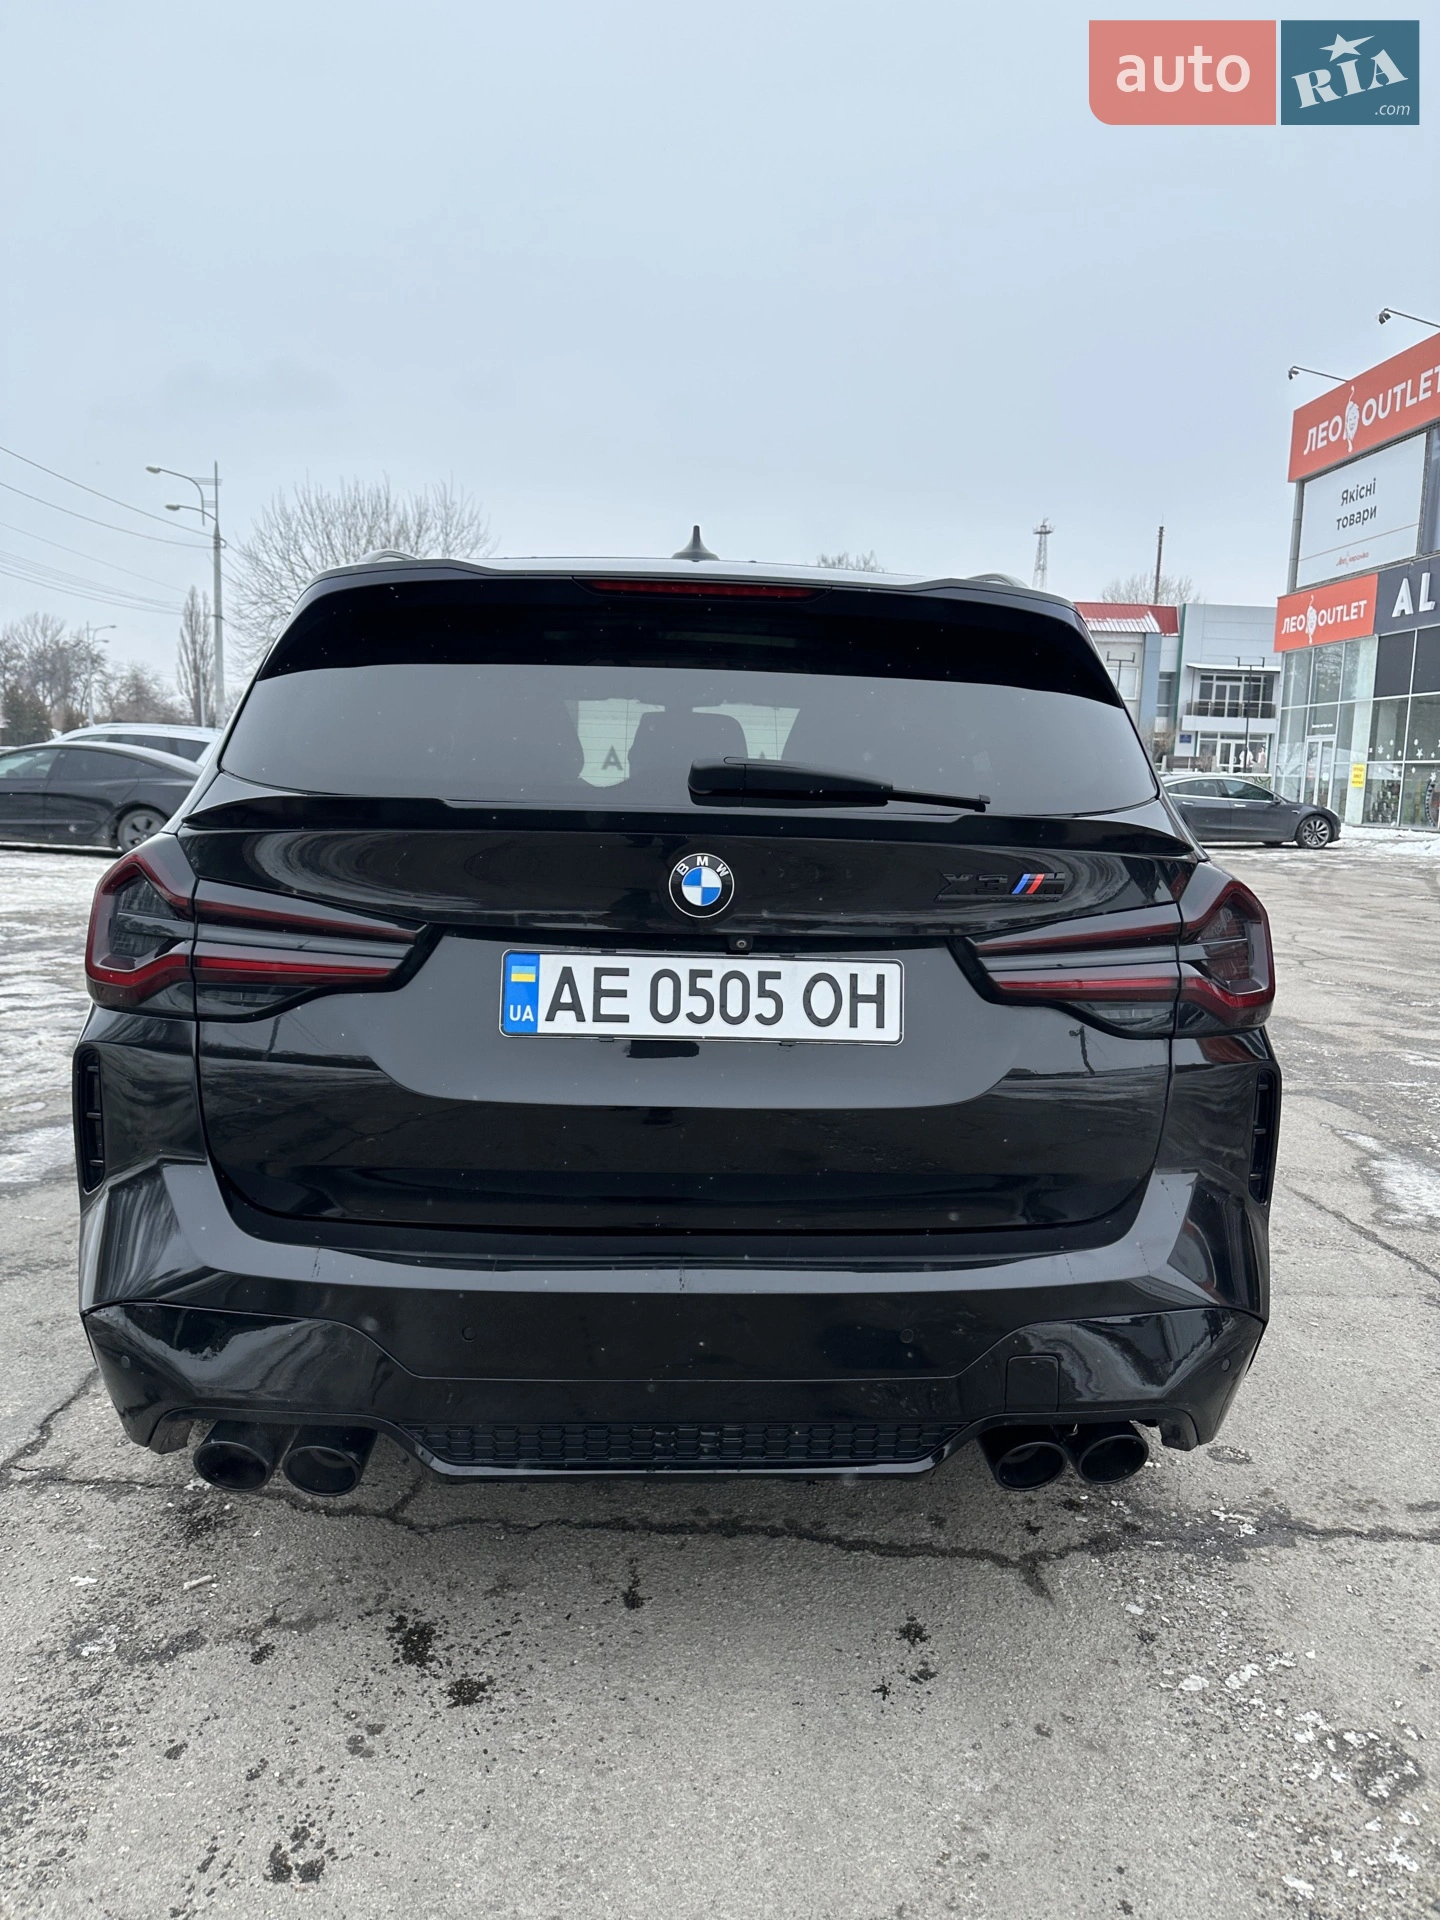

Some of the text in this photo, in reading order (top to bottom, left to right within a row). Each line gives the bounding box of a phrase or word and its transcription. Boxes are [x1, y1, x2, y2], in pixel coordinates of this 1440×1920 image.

[1303, 415, 1342, 455] ЛЕО
[1340, 477, 1377, 506] Якісні
[1336, 506, 1377, 531] товари
[1281, 600, 1367, 634] ЛЕО OUTLET
[676, 855, 730, 877] BMW
[545, 966, 885, 1029] AE 0505 OH
[509, 1004, 534, 1023] UA
